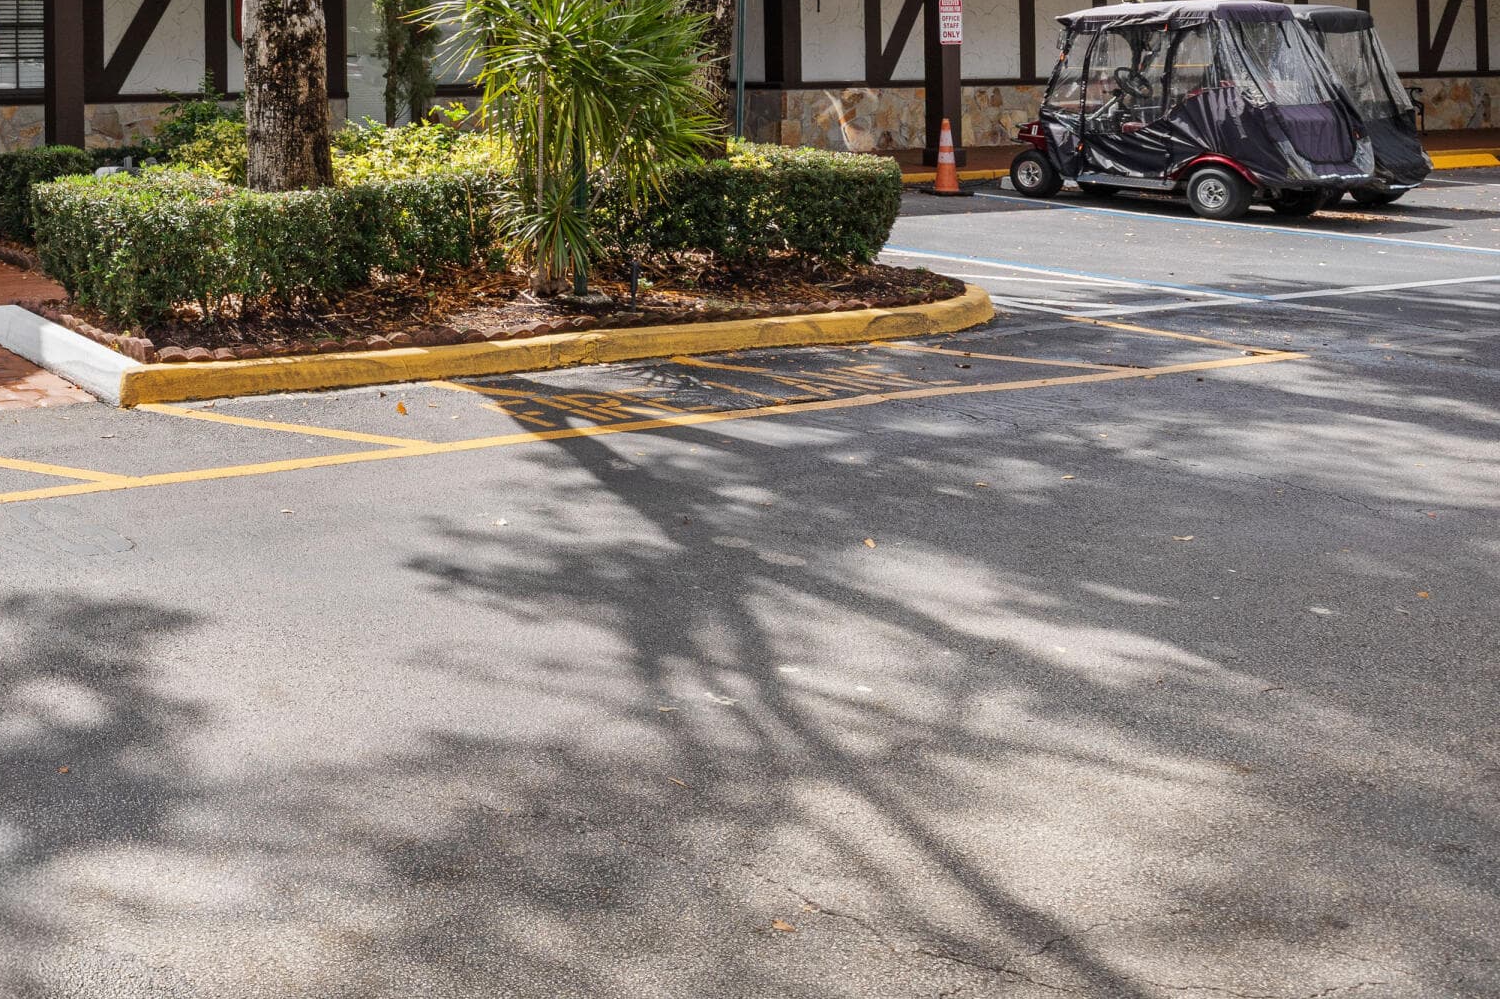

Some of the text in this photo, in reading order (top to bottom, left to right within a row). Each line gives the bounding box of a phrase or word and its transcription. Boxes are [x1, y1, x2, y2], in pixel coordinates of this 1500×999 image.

[942, 31, 960, 39] ONLY
[479, 364, 961, 427] FIRE LANE
